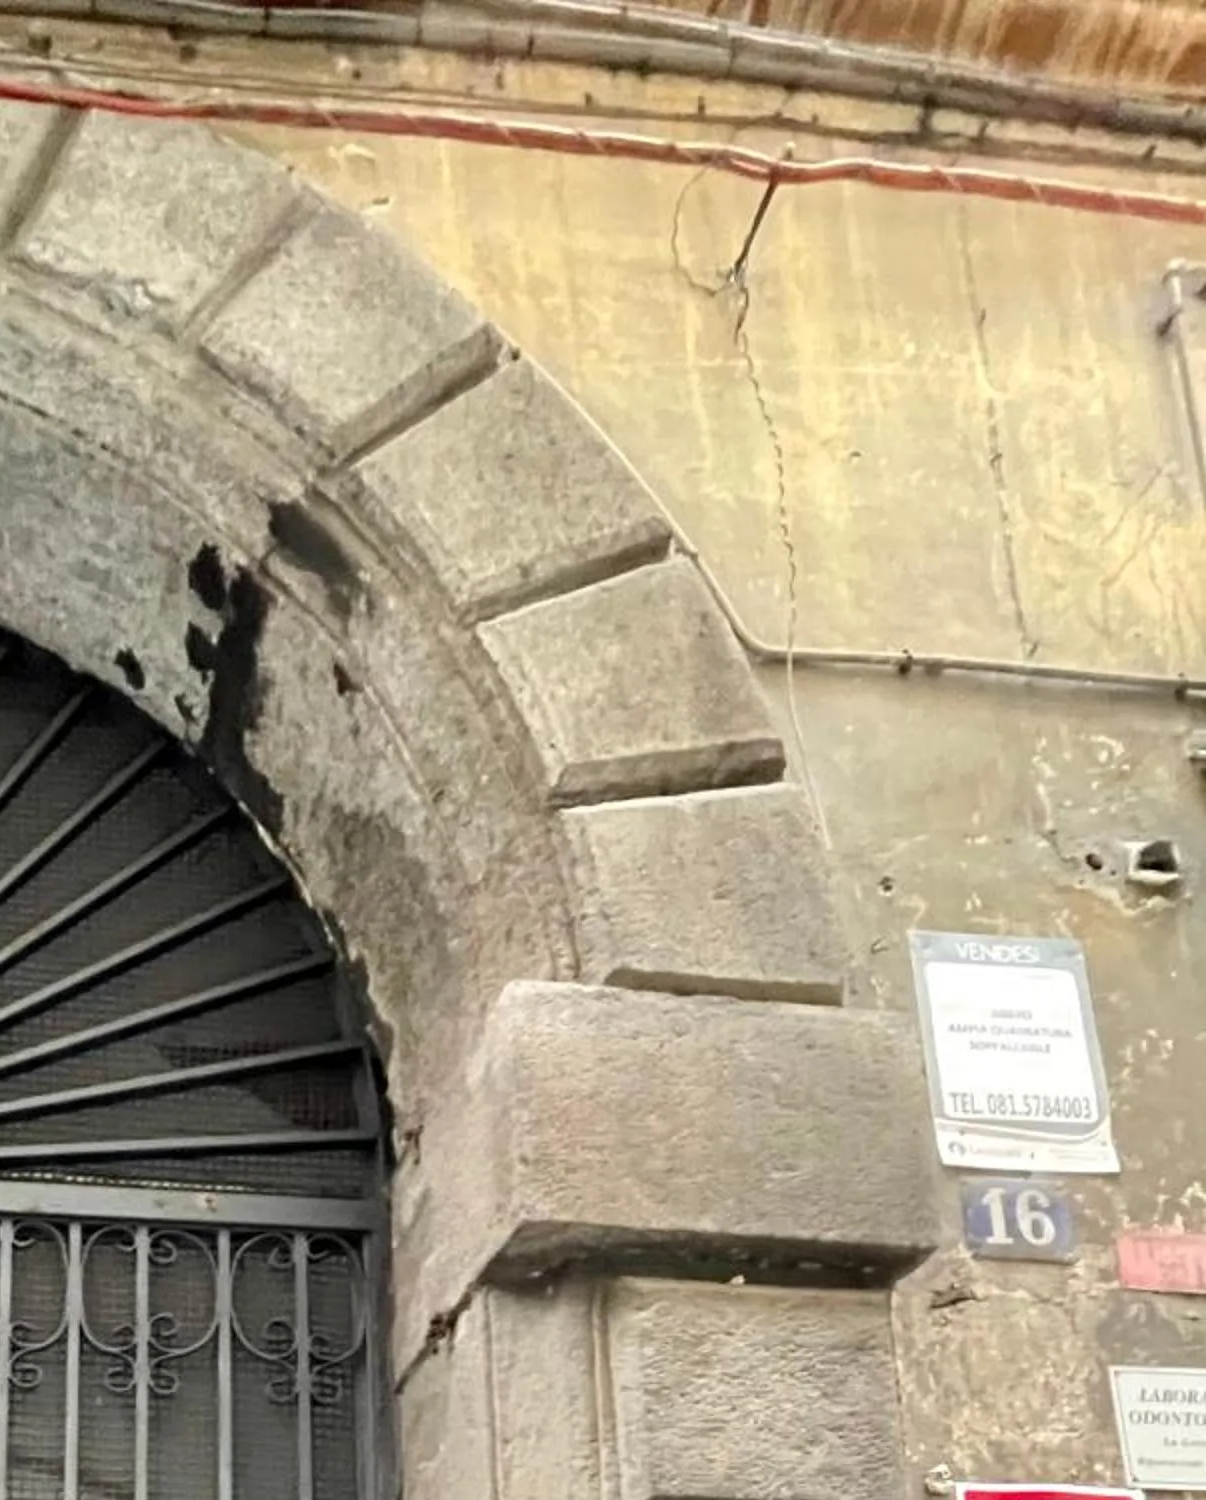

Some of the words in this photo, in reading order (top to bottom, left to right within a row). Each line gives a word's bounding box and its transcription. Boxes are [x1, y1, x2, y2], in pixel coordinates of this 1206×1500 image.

[954, 942, 1040, 964] VENDESI
[986, 1092, 1092, 1119] 081.5784003
[980, 1187, 1056, 1247] 16
